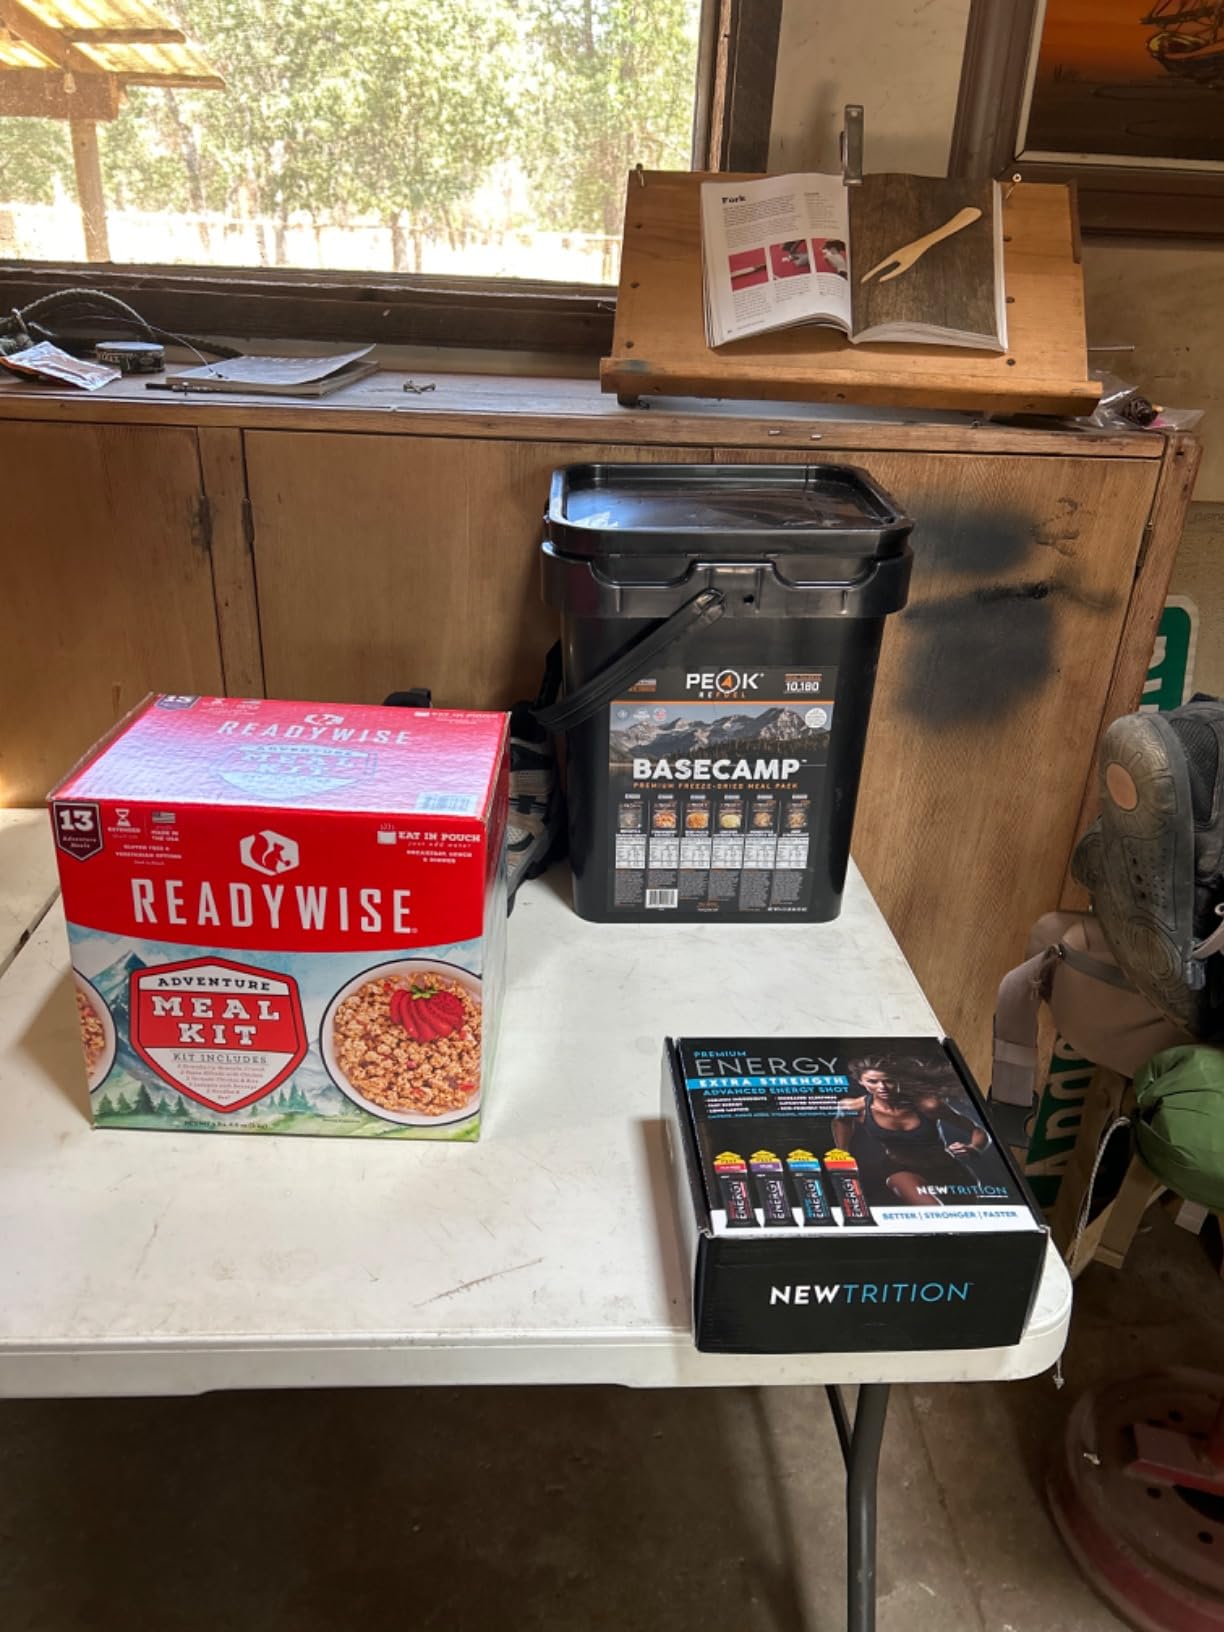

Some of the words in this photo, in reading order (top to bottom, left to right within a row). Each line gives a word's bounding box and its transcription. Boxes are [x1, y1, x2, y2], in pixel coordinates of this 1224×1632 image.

[721, 194, 747, 204] Fork
[217, 720, 411, 746] READYWISE
[632, 758, 800, 780] BASECAMP
[60, 809, 93, 831] 13
[398, 831, 420, 840] EAT
[424, 832, 438, 841] IN
[441, 833, 481, 842] POUCH
[131, 878, 411, 934] READYWISE
[157, 975, 271, 992] ADVENTURE
[151, 995, 279, 1022] MEAL
[179, 1024, 258, 1046] KIT
[173, 1053, 195, 1062] KIT
[201, 1054, 267, 1064] INCLUDES
[693, 1050, 747, 1058] PREMIUM
[695, 1057, 838, 1077] ENERGY
[699, 1078, 751, 1088] EXTRA
[759, 1076, 844, 1086] STRENGTH
[703, 1087, 767, 1097] ADVANCED
[769, 1087, 815, 1095] ENERGY
[818, 1086, 849, 1094] SHOT
[916, 1184, 1008, 1196] NEWTRITION
[882, 1211, 917, 1221] BETTER
[923, 1210, 977, 1220] STRONGER
[983, 1210, 1018, 1219] FASTER
[769, 1282, 970, 1305] NEWTRITION
